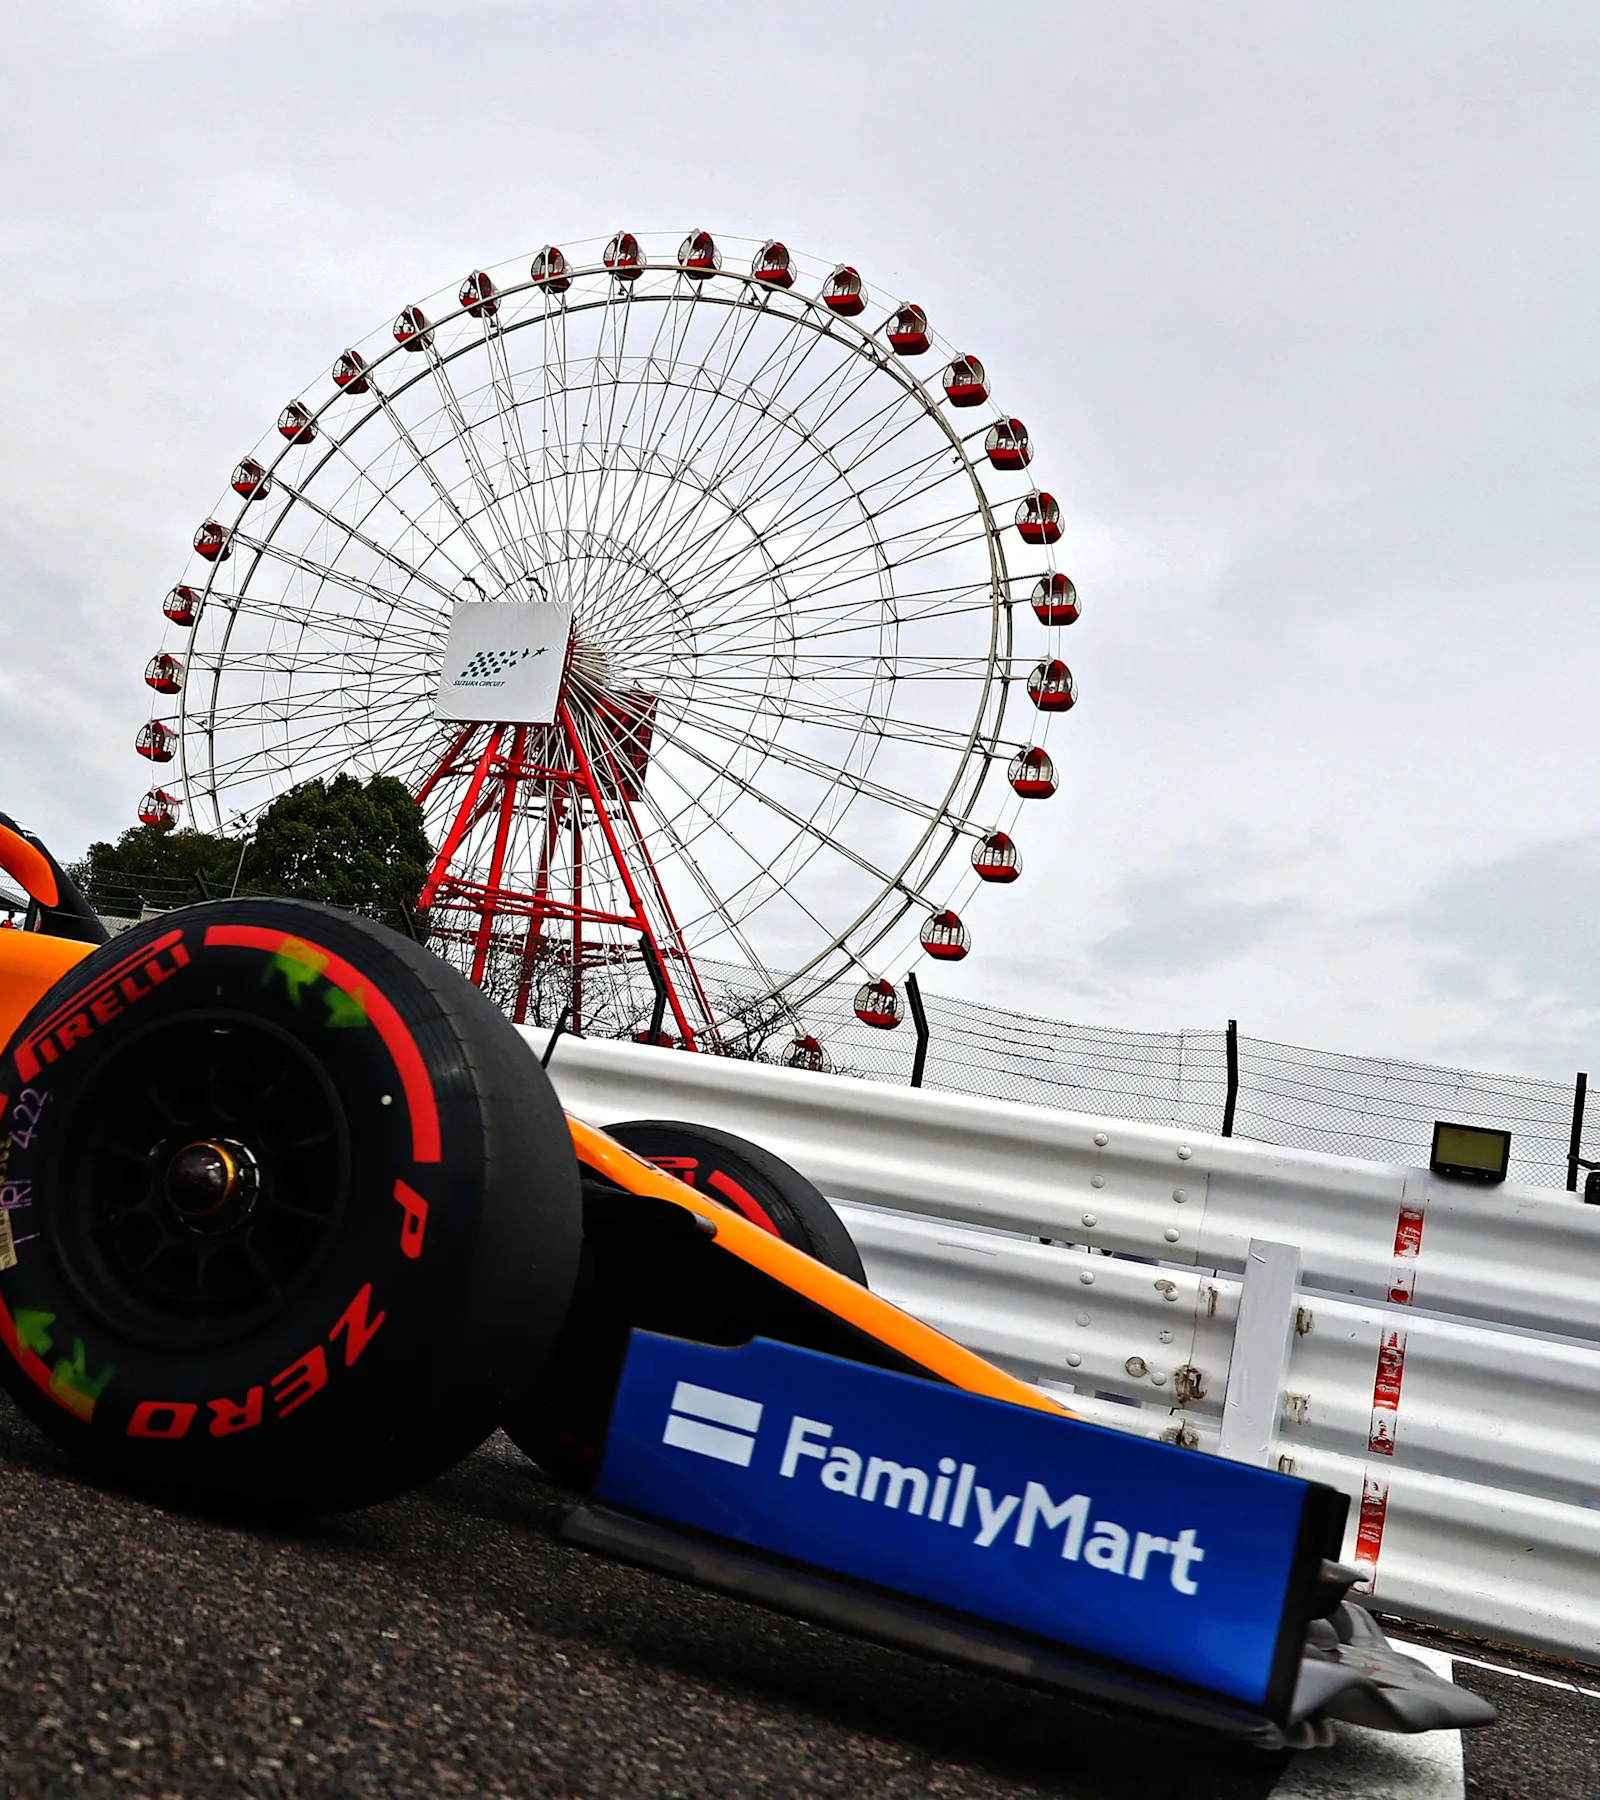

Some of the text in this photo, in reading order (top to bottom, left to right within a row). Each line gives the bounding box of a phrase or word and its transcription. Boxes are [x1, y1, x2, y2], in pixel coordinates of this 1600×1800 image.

[13, 928, 192, 1085] PIRELLI
[8, 1088, 49, 1149] 422
[126, 1283, 386, 1439] ZERO
[779, 1415, 1205, 1596] FamilyMart
